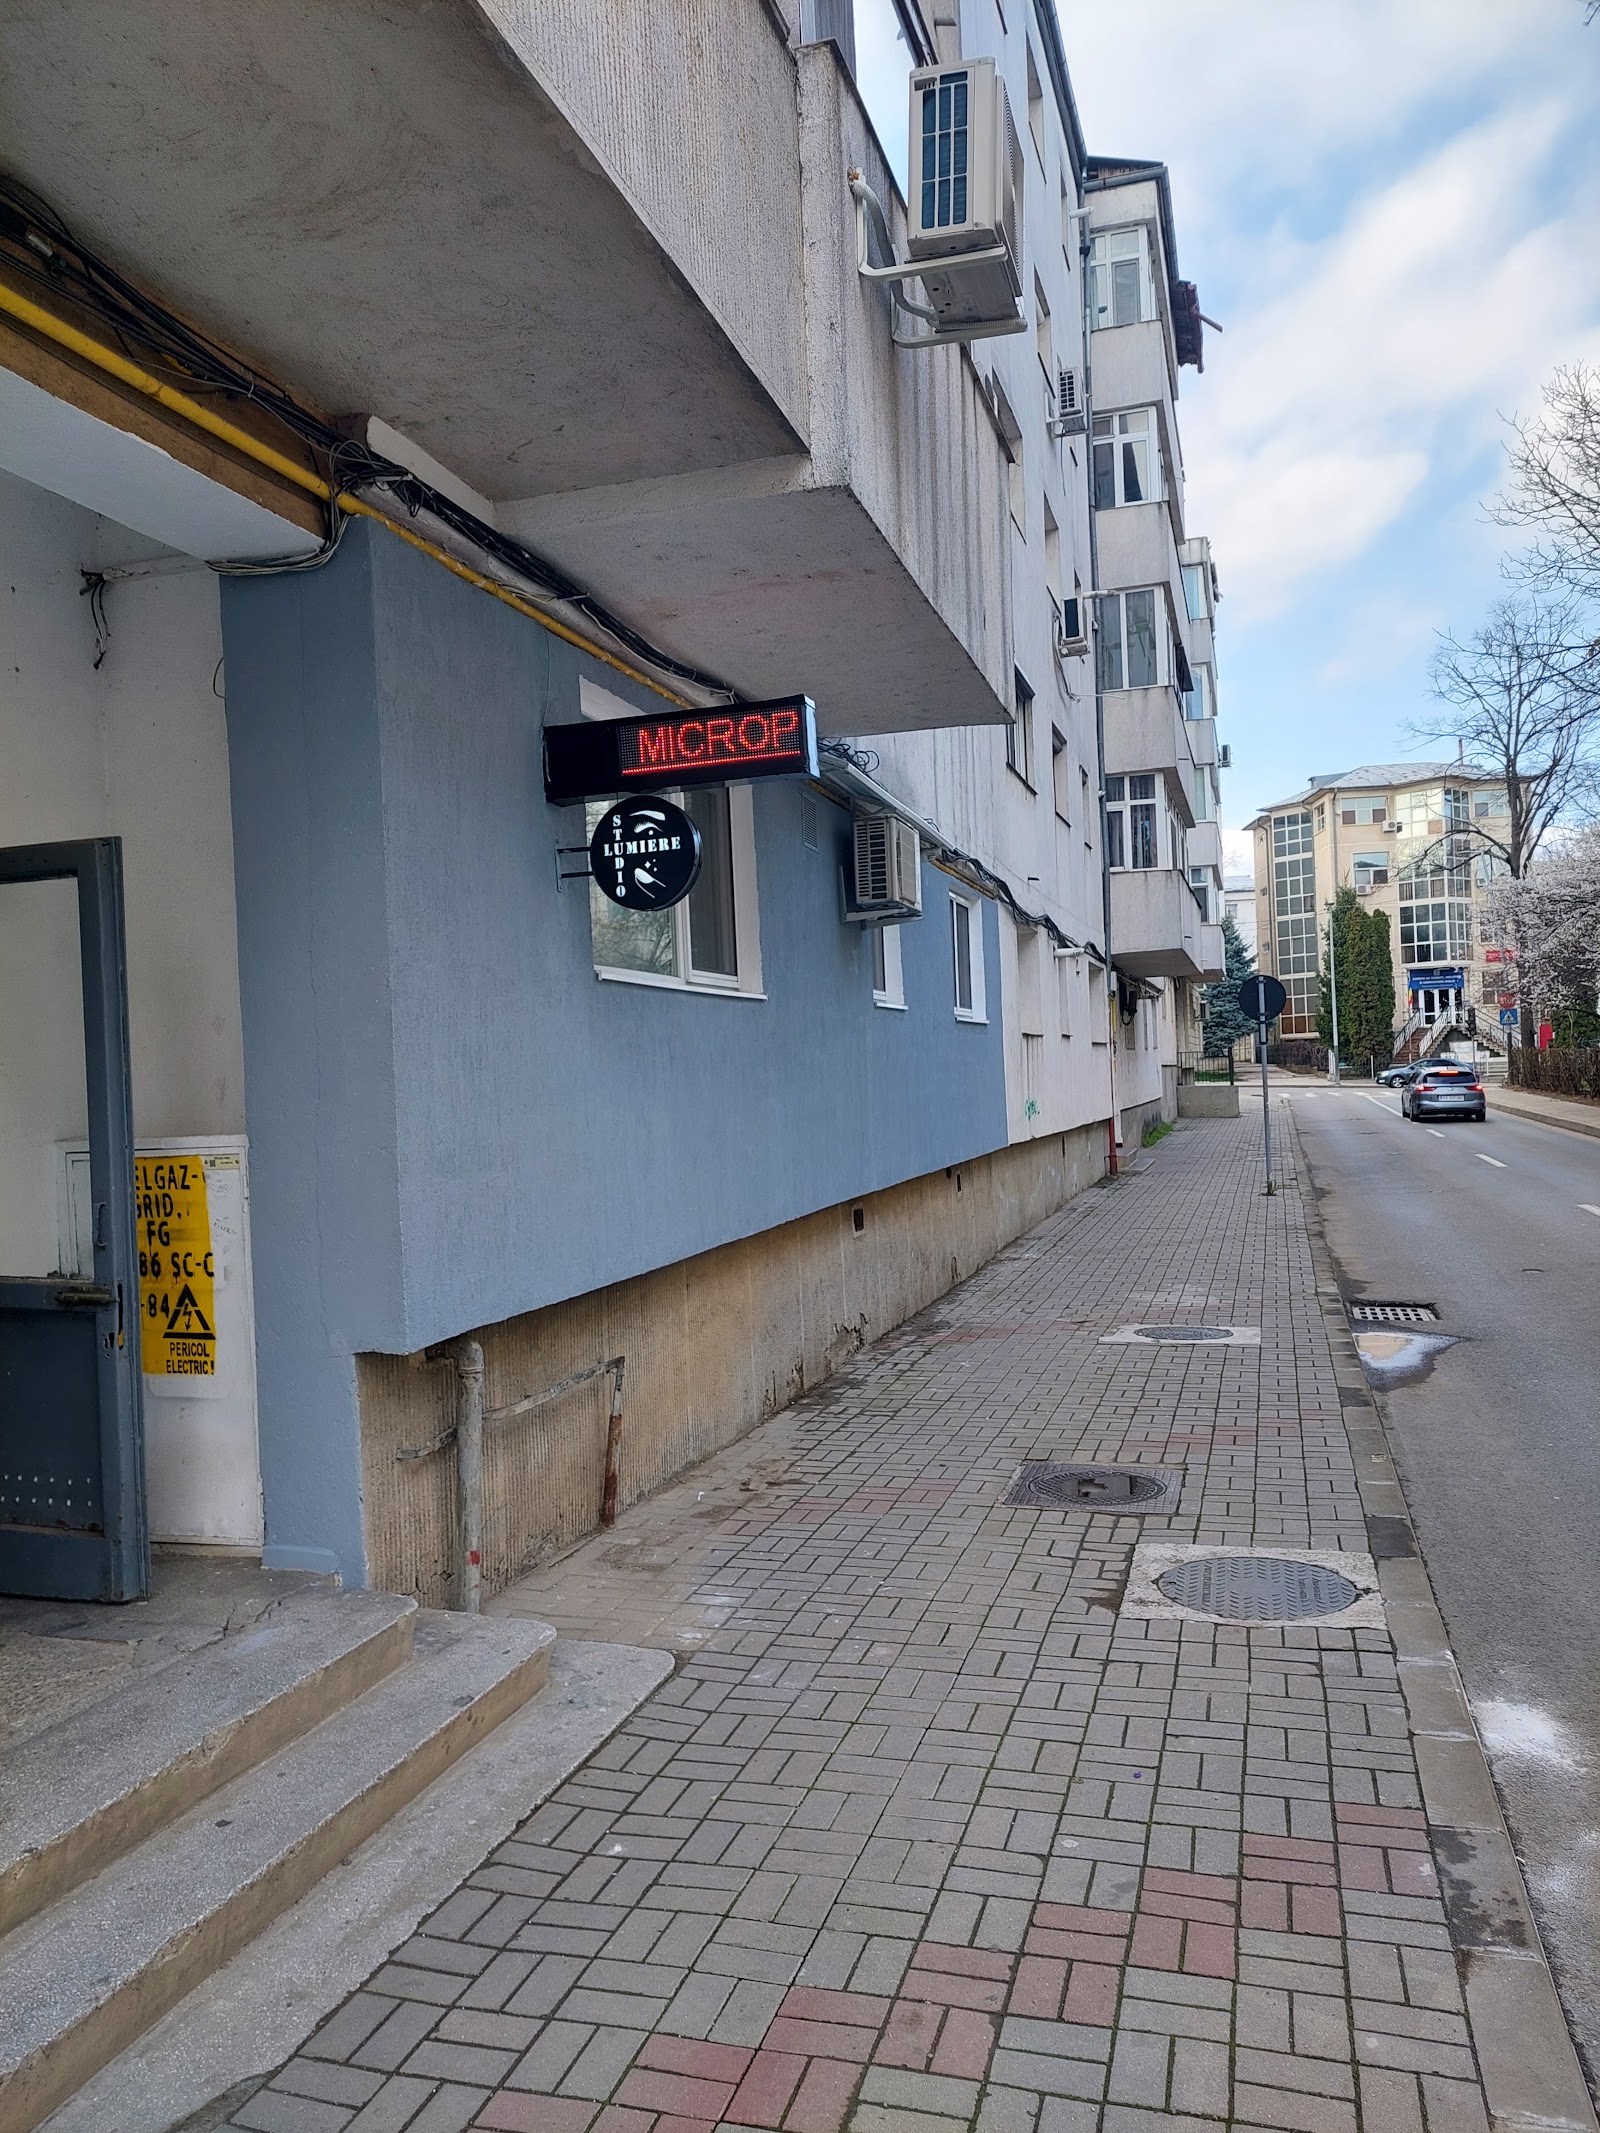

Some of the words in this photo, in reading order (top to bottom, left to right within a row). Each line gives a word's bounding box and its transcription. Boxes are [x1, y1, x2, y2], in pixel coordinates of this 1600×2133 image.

[638, 710, 799, 763] MICROP
[603, 836, 681, 857] LUMIERE
[612, 814, 627, 898] STUDIO
[147, 1221, 170, 1247] FG
[169, 1342, 210, 1357] PERICOL
